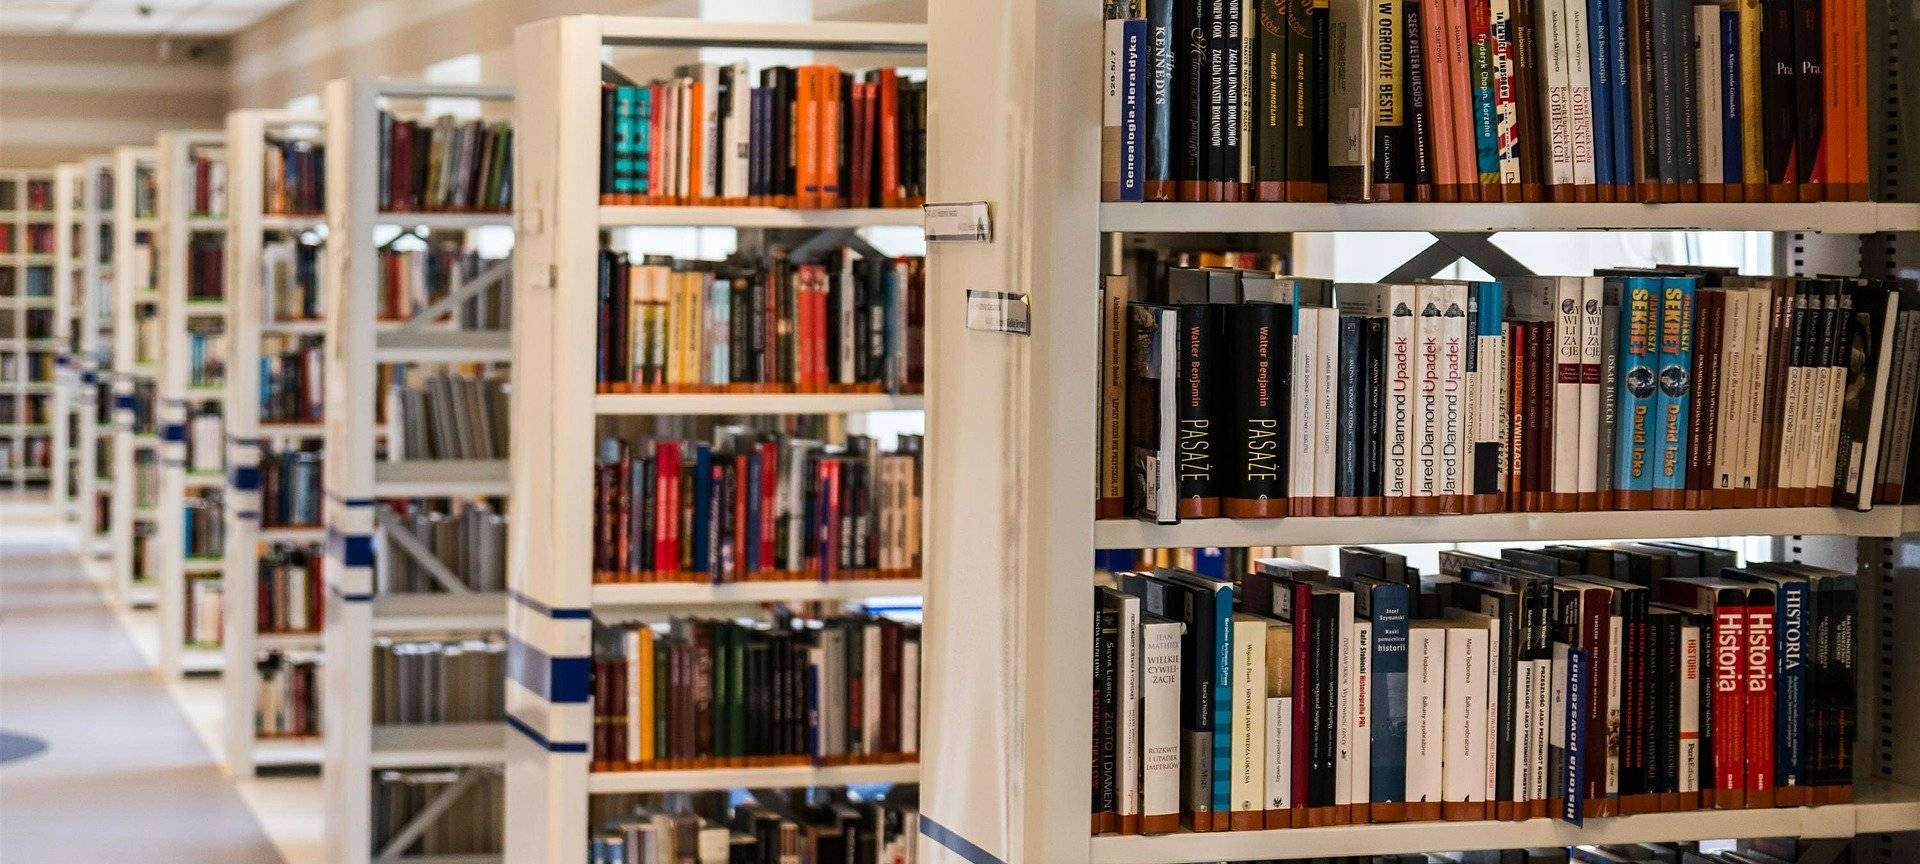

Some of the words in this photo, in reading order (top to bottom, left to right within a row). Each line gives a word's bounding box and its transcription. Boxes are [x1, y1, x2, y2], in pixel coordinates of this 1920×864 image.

[1379, 3, 1394, 16] W
[1212, 21, 1222, 39] COOK
[1227, 21, 1237, 39] COOK
[1379, 18, 1394, 79] OGRODZIE
[1496, 11, 1506, 51] TAJEMNICE
[1154, 25, 1166, 105] KENNEDYS
[1211, 49, 1222, 76] ZAGŁADA
[1227, 49, 1237, 76] ZAGŁADA
[1478, 33, 1488, 69] Fryderyk
[1211, 77, 1222, 104] DYNASTII
[1227, 77, 1238, 104] DYNASTII
[1410, 70, 1422, 107] LUKSUSU
[1498, 55, 1509, 96] WINDSORÓW
[1379, 84, 1394, 123] BESTII
[1482, 103, 1491, 137] Korzenie
[1211, 105, 1222, 147] ROMANOWÓW
[1227, 105, 1238, 146] ROMANOWÓW
[1550, 87, 1562, 164] SOBIESKICH
[1572, 87, 1585, 164] SOBIESKICH
[1384, 152, 1392, 180] LARSON
[1563, 315, 1578, 324] WI
[1565, 326, 1576, 335] LI
[1587, 315, 1601, 324] WI
[1589, 326, 1599, 335] LI
[1629, 288, 1648, 356] SEKRET
[1662, 287, 1682, 356] SEKRET
[1190, 326, 1199, 358] Walter
[1258, 326, 1268, 358] Walter
[1561, 346, 1579, 357] CJE
[1563, 336, 1578, 346] ZA
[1584, 346, 1600, 357] CJE
[1587, 336, 1600, 346] ZA
[1392, 336, 1410, 392] Upadek
[1422, 336, 1439, 392] Upadek
[1444, 336, 1461, 392] Upadek
[1607, 355, 1615, 384] OSKAR
[1188, 361, 1200, 408] Benjamin
[1257, 361, 1269, 408] Benjamin
[1787, 369, 1799, 402] GRANICE
[1391, 394, 1405, 456] Diamond
[1420, 394, 1434, 456] Diamond
[1443, 394, 1457, 456] Diamond
[1635, 405, 1647, 443] David
[1666, 404, 1680, 442] David
[1786, 402, 1797, 433] HISTORII
[1801, 394, 1810, 420] HISTORII
[1181, 419, 1212, 482] PASAŻE
[1247, 419, 1280, 482] PASAŻE
[1513, 413, 1523, 476] CYWILIZACJE
[1632, 447, 1644, 478] Icke
[1664, 446, 1678, 477] Icke
[1391, 458, 1405, 498] Jared
[1420, 458, 1434, 498] Jared
[1443, 458, 1456, 496] Jared
[1359, 629, 1367, 646] Rafał
[1377, 644, 1406, 652] historii
[1540, 626, 1548, 649] Woźniak
[1786, 589, 1801, 670] HISTORIA
[1106, 642, 1114, 668] SILVIA
[1147, 655, 1179, 664] WIELKIE
[1359, 647, 1367, 674] Stobiecki
[1422, 655, 1430, 684] Todorova
[1465, 655, 1473, 684] Todorova
[1687, 639, 1697, 680] HISTORIA
[1718, 613, 1743, 693] Historia
[1748, 613, 1773, 693] Historia
[1152, 674, 1176, 685] ZACJE
[1358, 675, 1366, 715] Historiografia
[1524, 668, 1532, 709] PRZESZŁOŚĆ
[1538, 666, 1547, 708] PRZESZŁOŚĆ
[1420, 695, 1428, 720] Bałkany
[1463, 695, 1471, 720] Bałkany
[1568, 653, 1580, 752] powszechna
[1104, 712, 1115, 752] ZŁOTO
[1148, 745, 1178, 754] ROZKWIT
[1522, 730, 1530, 767] PRZEDMIOT
[1537, 728, 1545, 765] PRZEDMIOT
[1566, 755, 1577, 819] Historia
